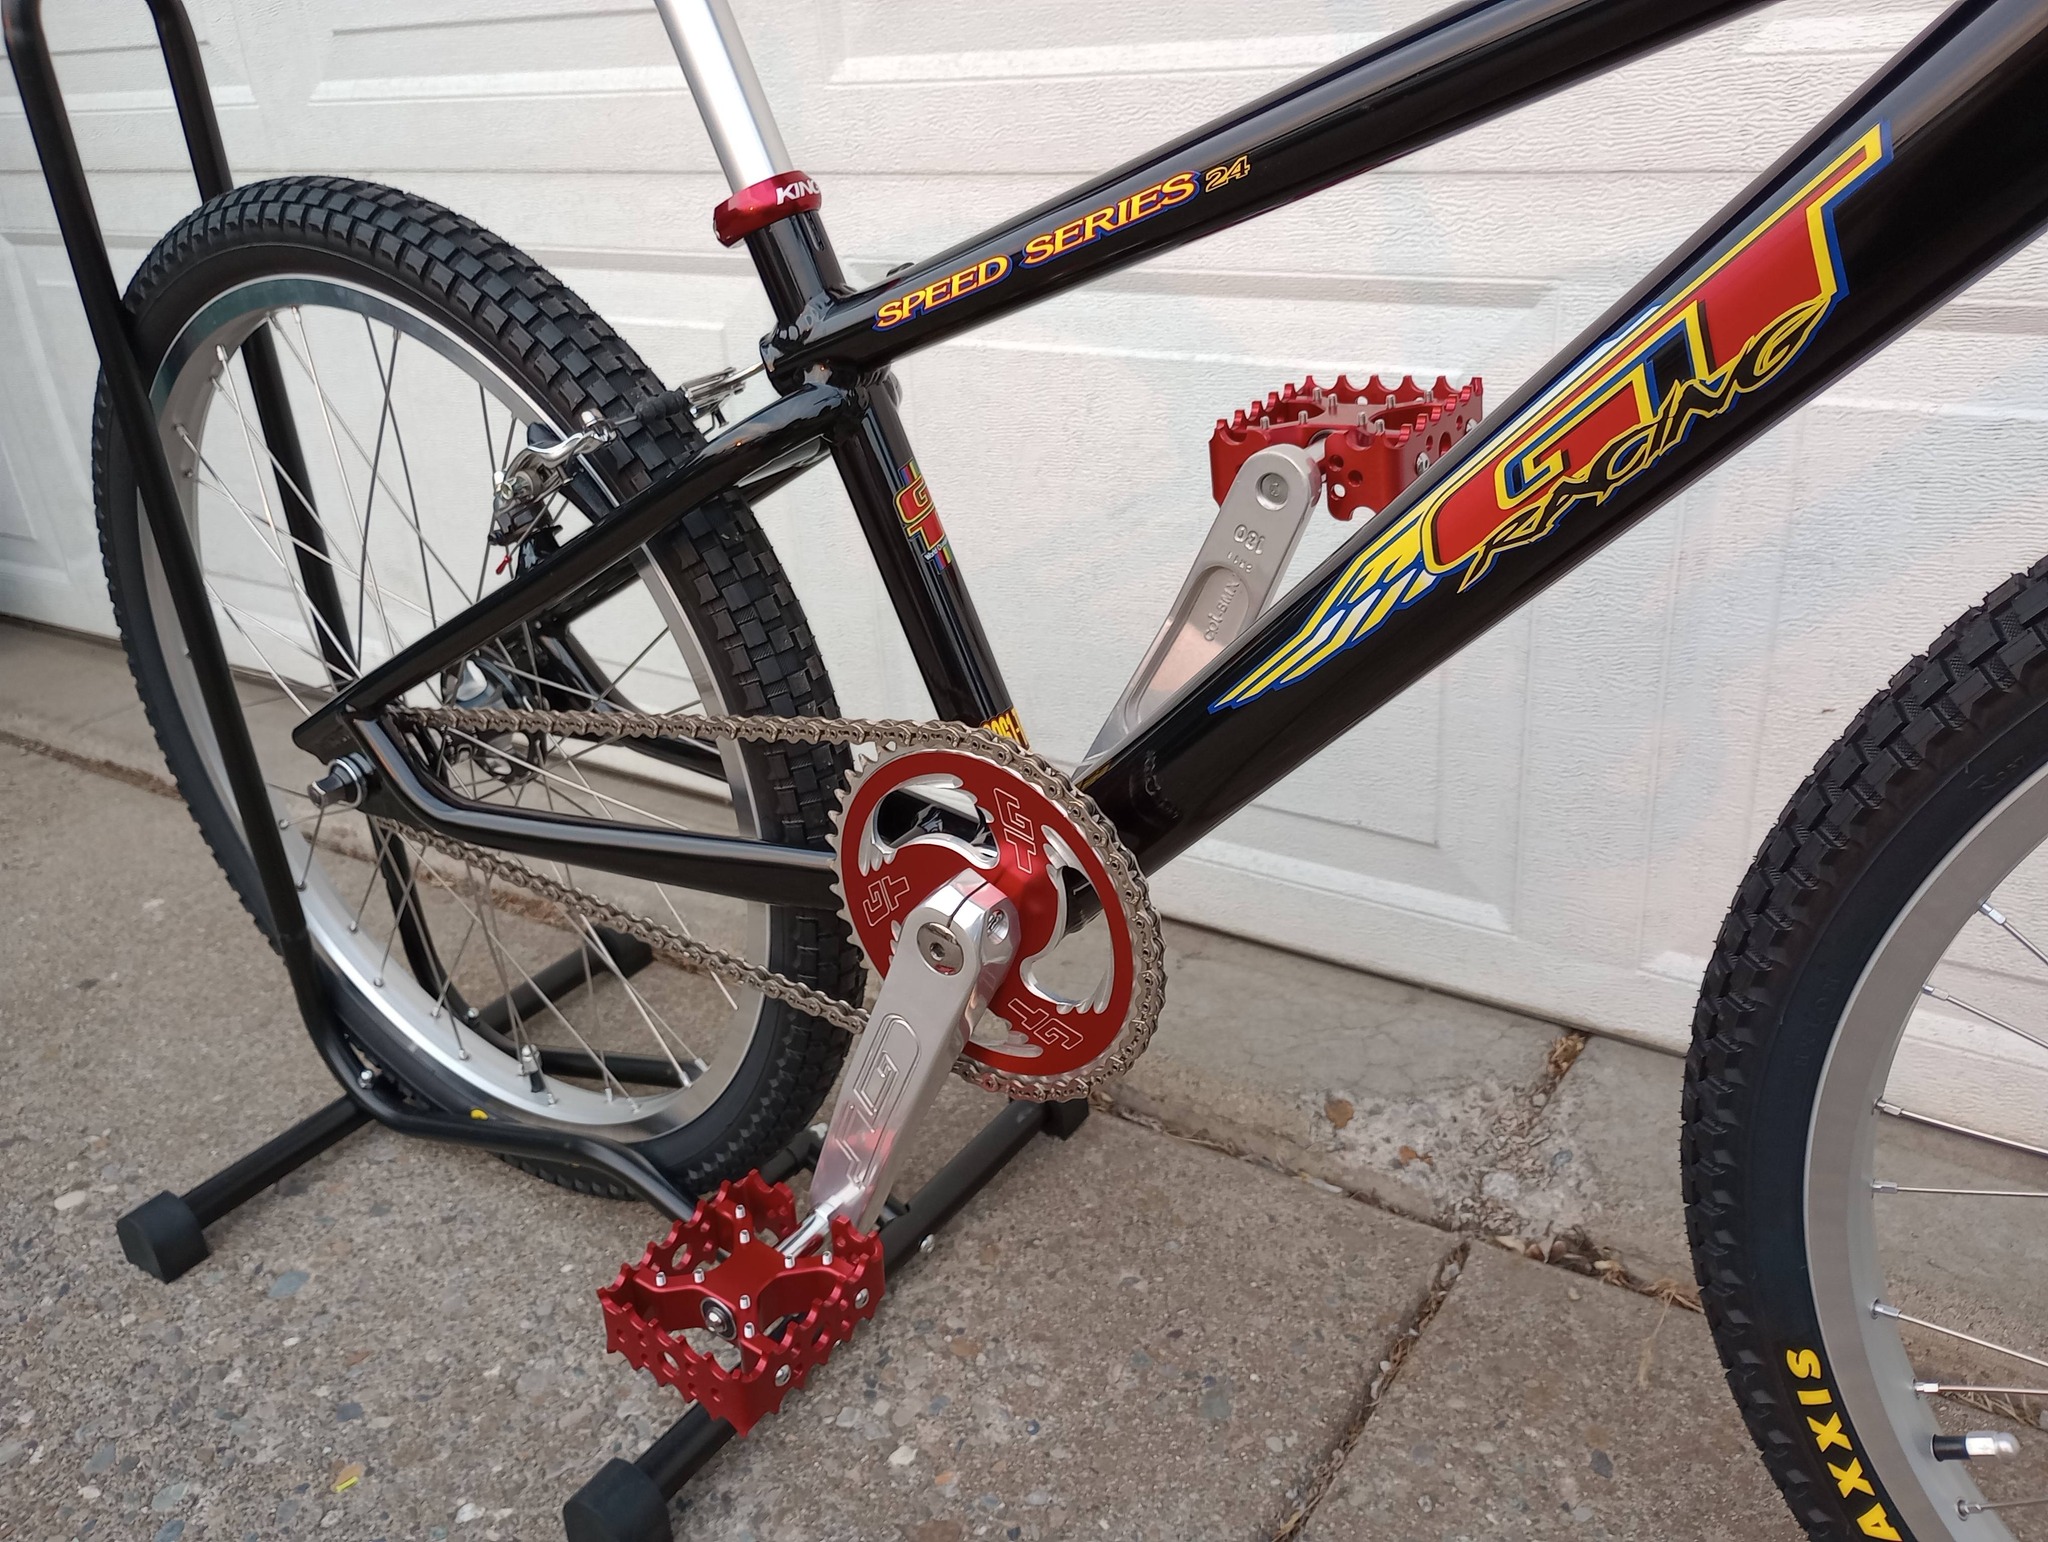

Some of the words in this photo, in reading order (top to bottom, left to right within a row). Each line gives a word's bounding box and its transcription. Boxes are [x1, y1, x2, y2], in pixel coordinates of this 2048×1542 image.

[776, 179, 820, 205] KING
[873, 255, 1012, 331] SPEED
[1020, 170, 1200, 269] SERIES
[1205, 155, 1251, 192] 24
[1421, 118, 1893, 574] GT
[895, 475, 945, 550] GT
[993, 788, 1036, 874] GT
[863, 875, 910, 927] GT
[1008, 997, 1084, 1050] GT
